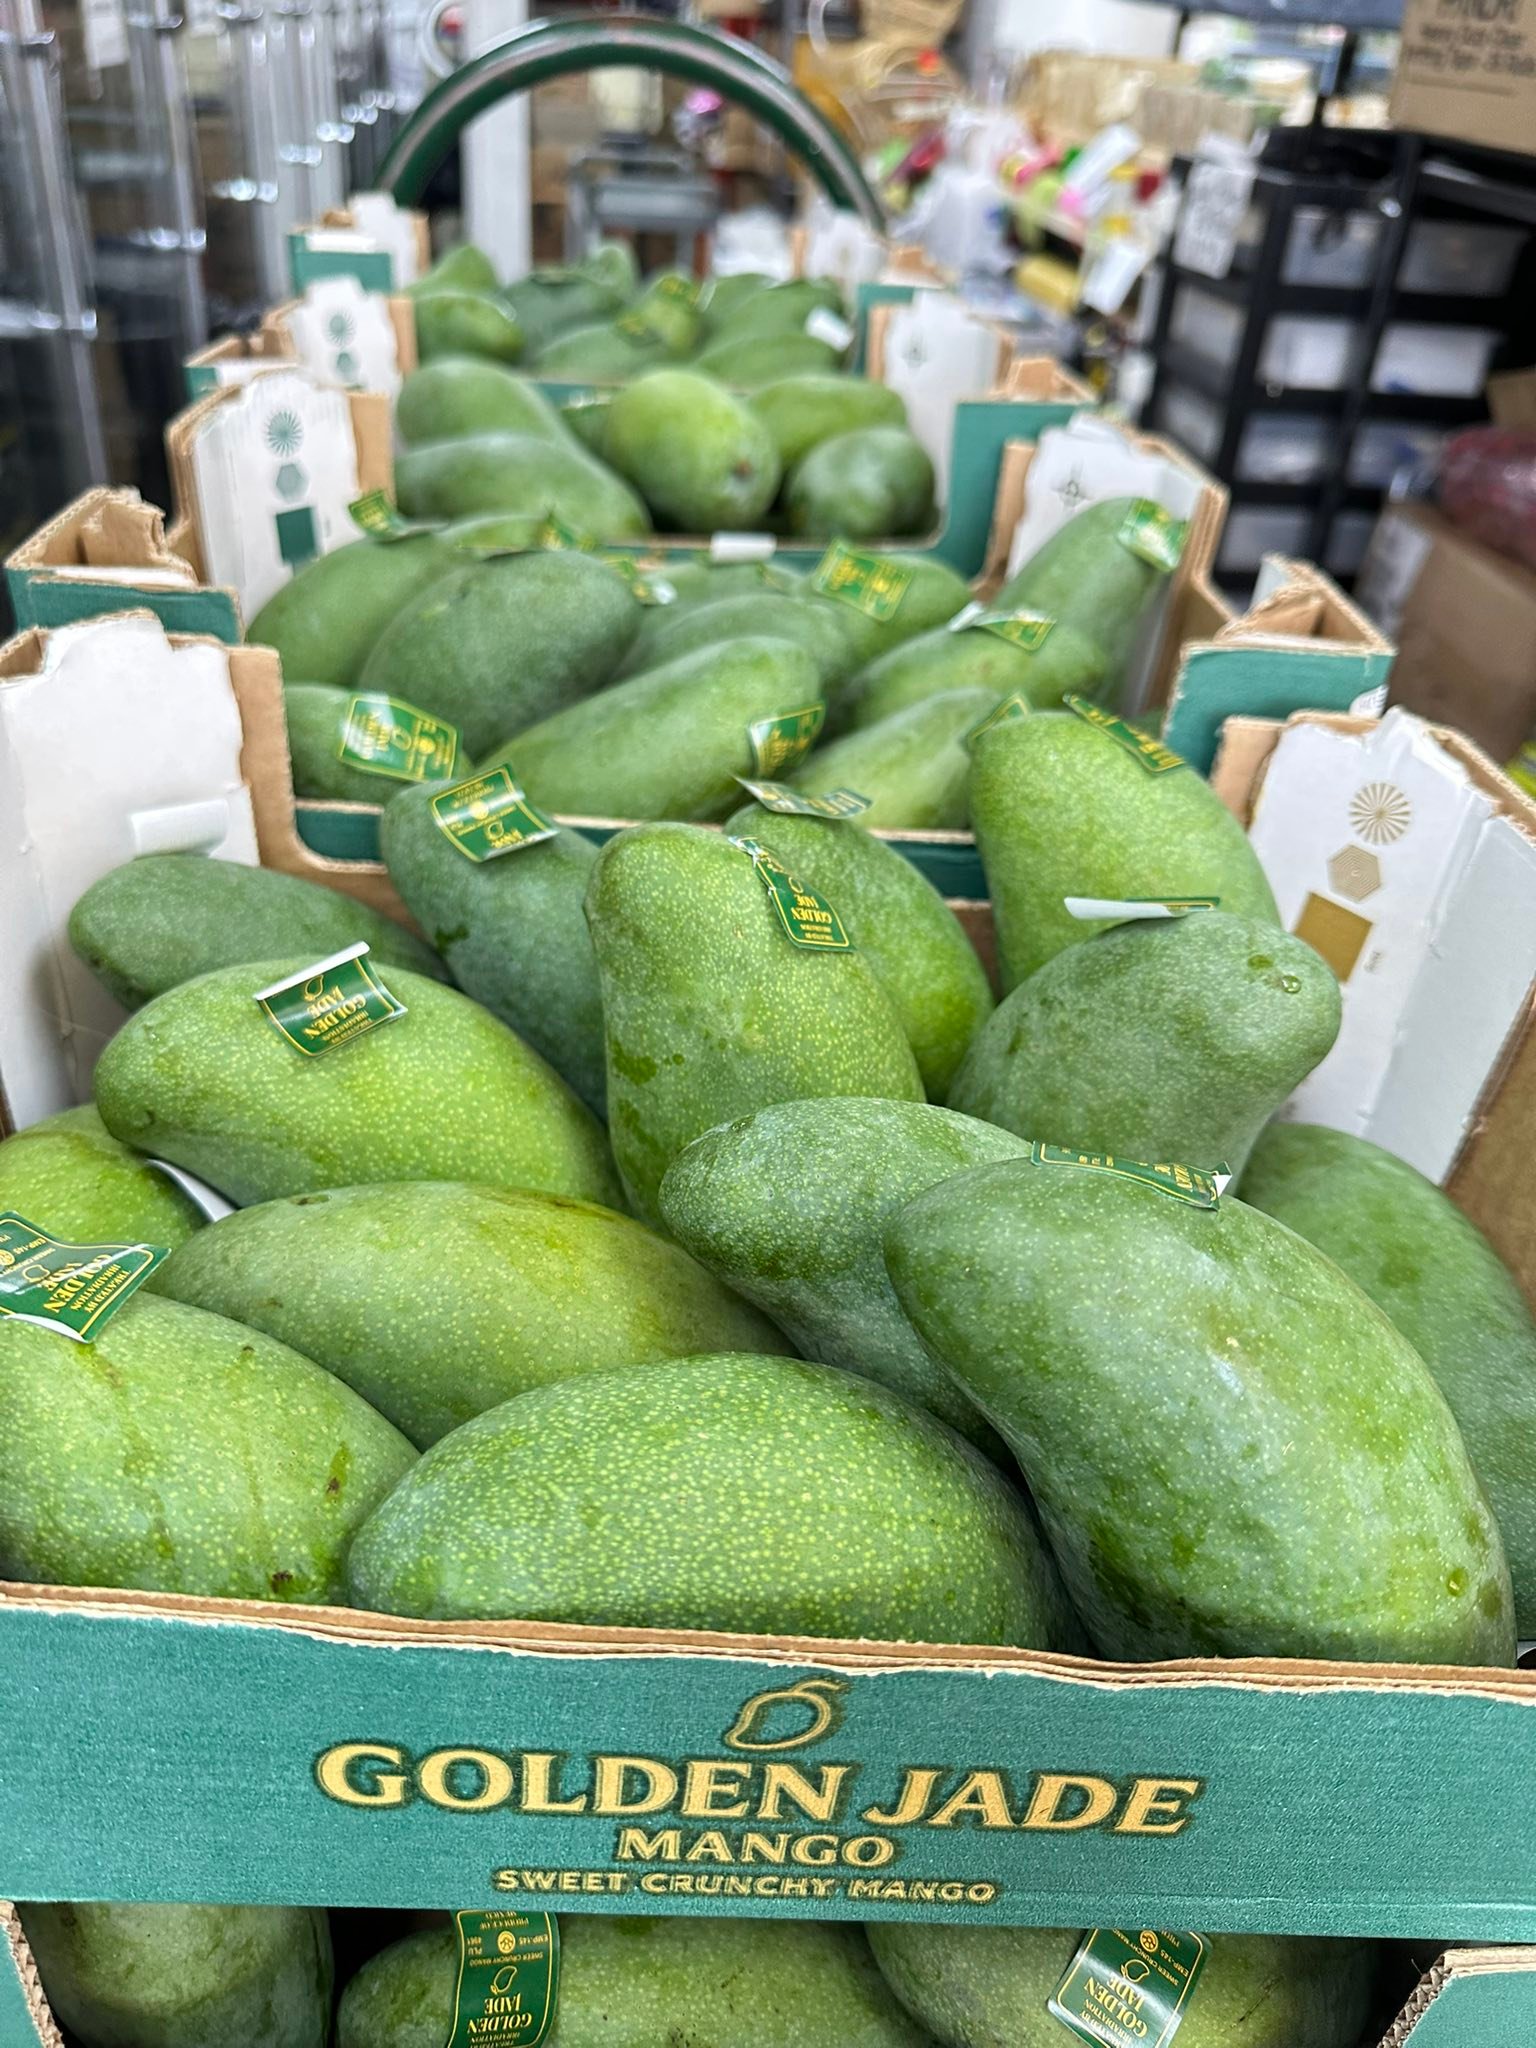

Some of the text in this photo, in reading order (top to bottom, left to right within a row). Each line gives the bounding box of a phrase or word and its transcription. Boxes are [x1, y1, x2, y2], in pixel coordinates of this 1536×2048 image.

[304, 994, 366, 1039] GOLDEN
[308, 986, 344, 1018] JADE
[70, 1264, 121, 1310] IRRADIATION
[316, 1743, 1199, 1833] GOLDEN JADE
[617, 1828, 895, 1868] MANGO
[496, 1870, 995, 1903] SWEET CRUNCHY MANGO
[1159, 1949, 1189, 1977] EMP-145
[484, 1993, 521, 2014] JADE
[1083, 1977, 1148, 2038] GOLDEN
[1106, 1976, 1145, 2012] JADE
[467, 2013, 532, 2033] GOLDEN
[1083, 1999, 1132, 2044] IRRADIATION
